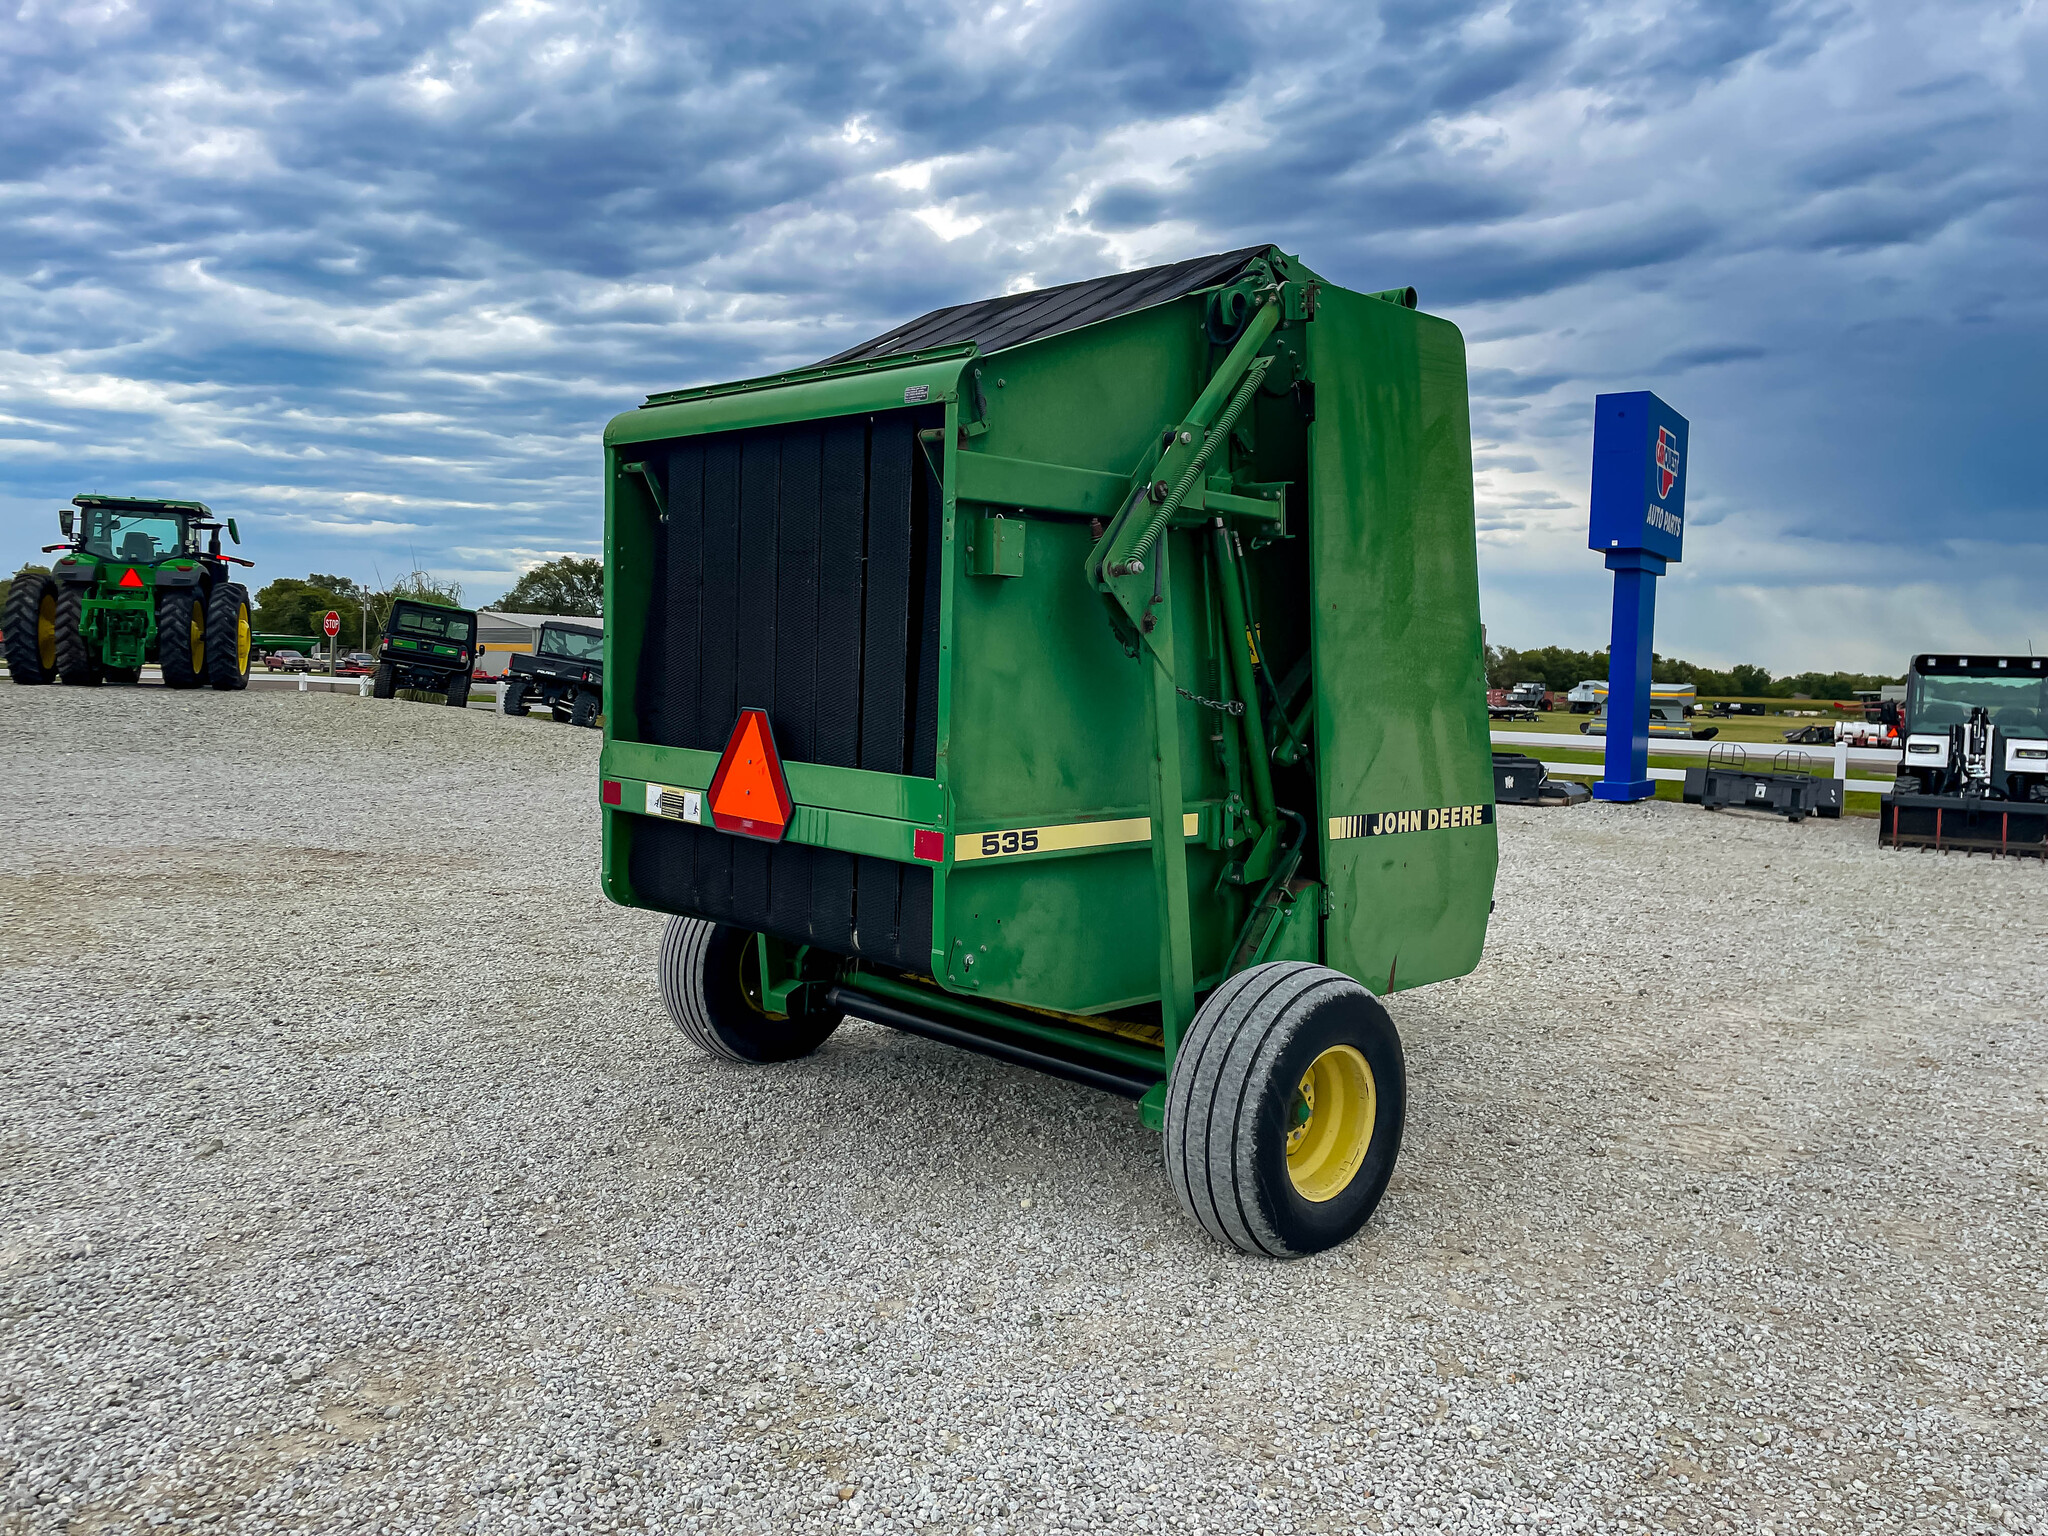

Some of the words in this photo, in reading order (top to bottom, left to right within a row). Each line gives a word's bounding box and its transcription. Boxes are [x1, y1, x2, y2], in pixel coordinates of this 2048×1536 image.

[1646, 503, 1664, 530] AUTO
[1663, 512, 1682, 538] PARTS
[325, 618, 339, 629] STOP
[1373, 810, 1422, 836] JOHN
[1427, 805, 1484, 830] DEERE
[981, 830, 1039, 856] 535
